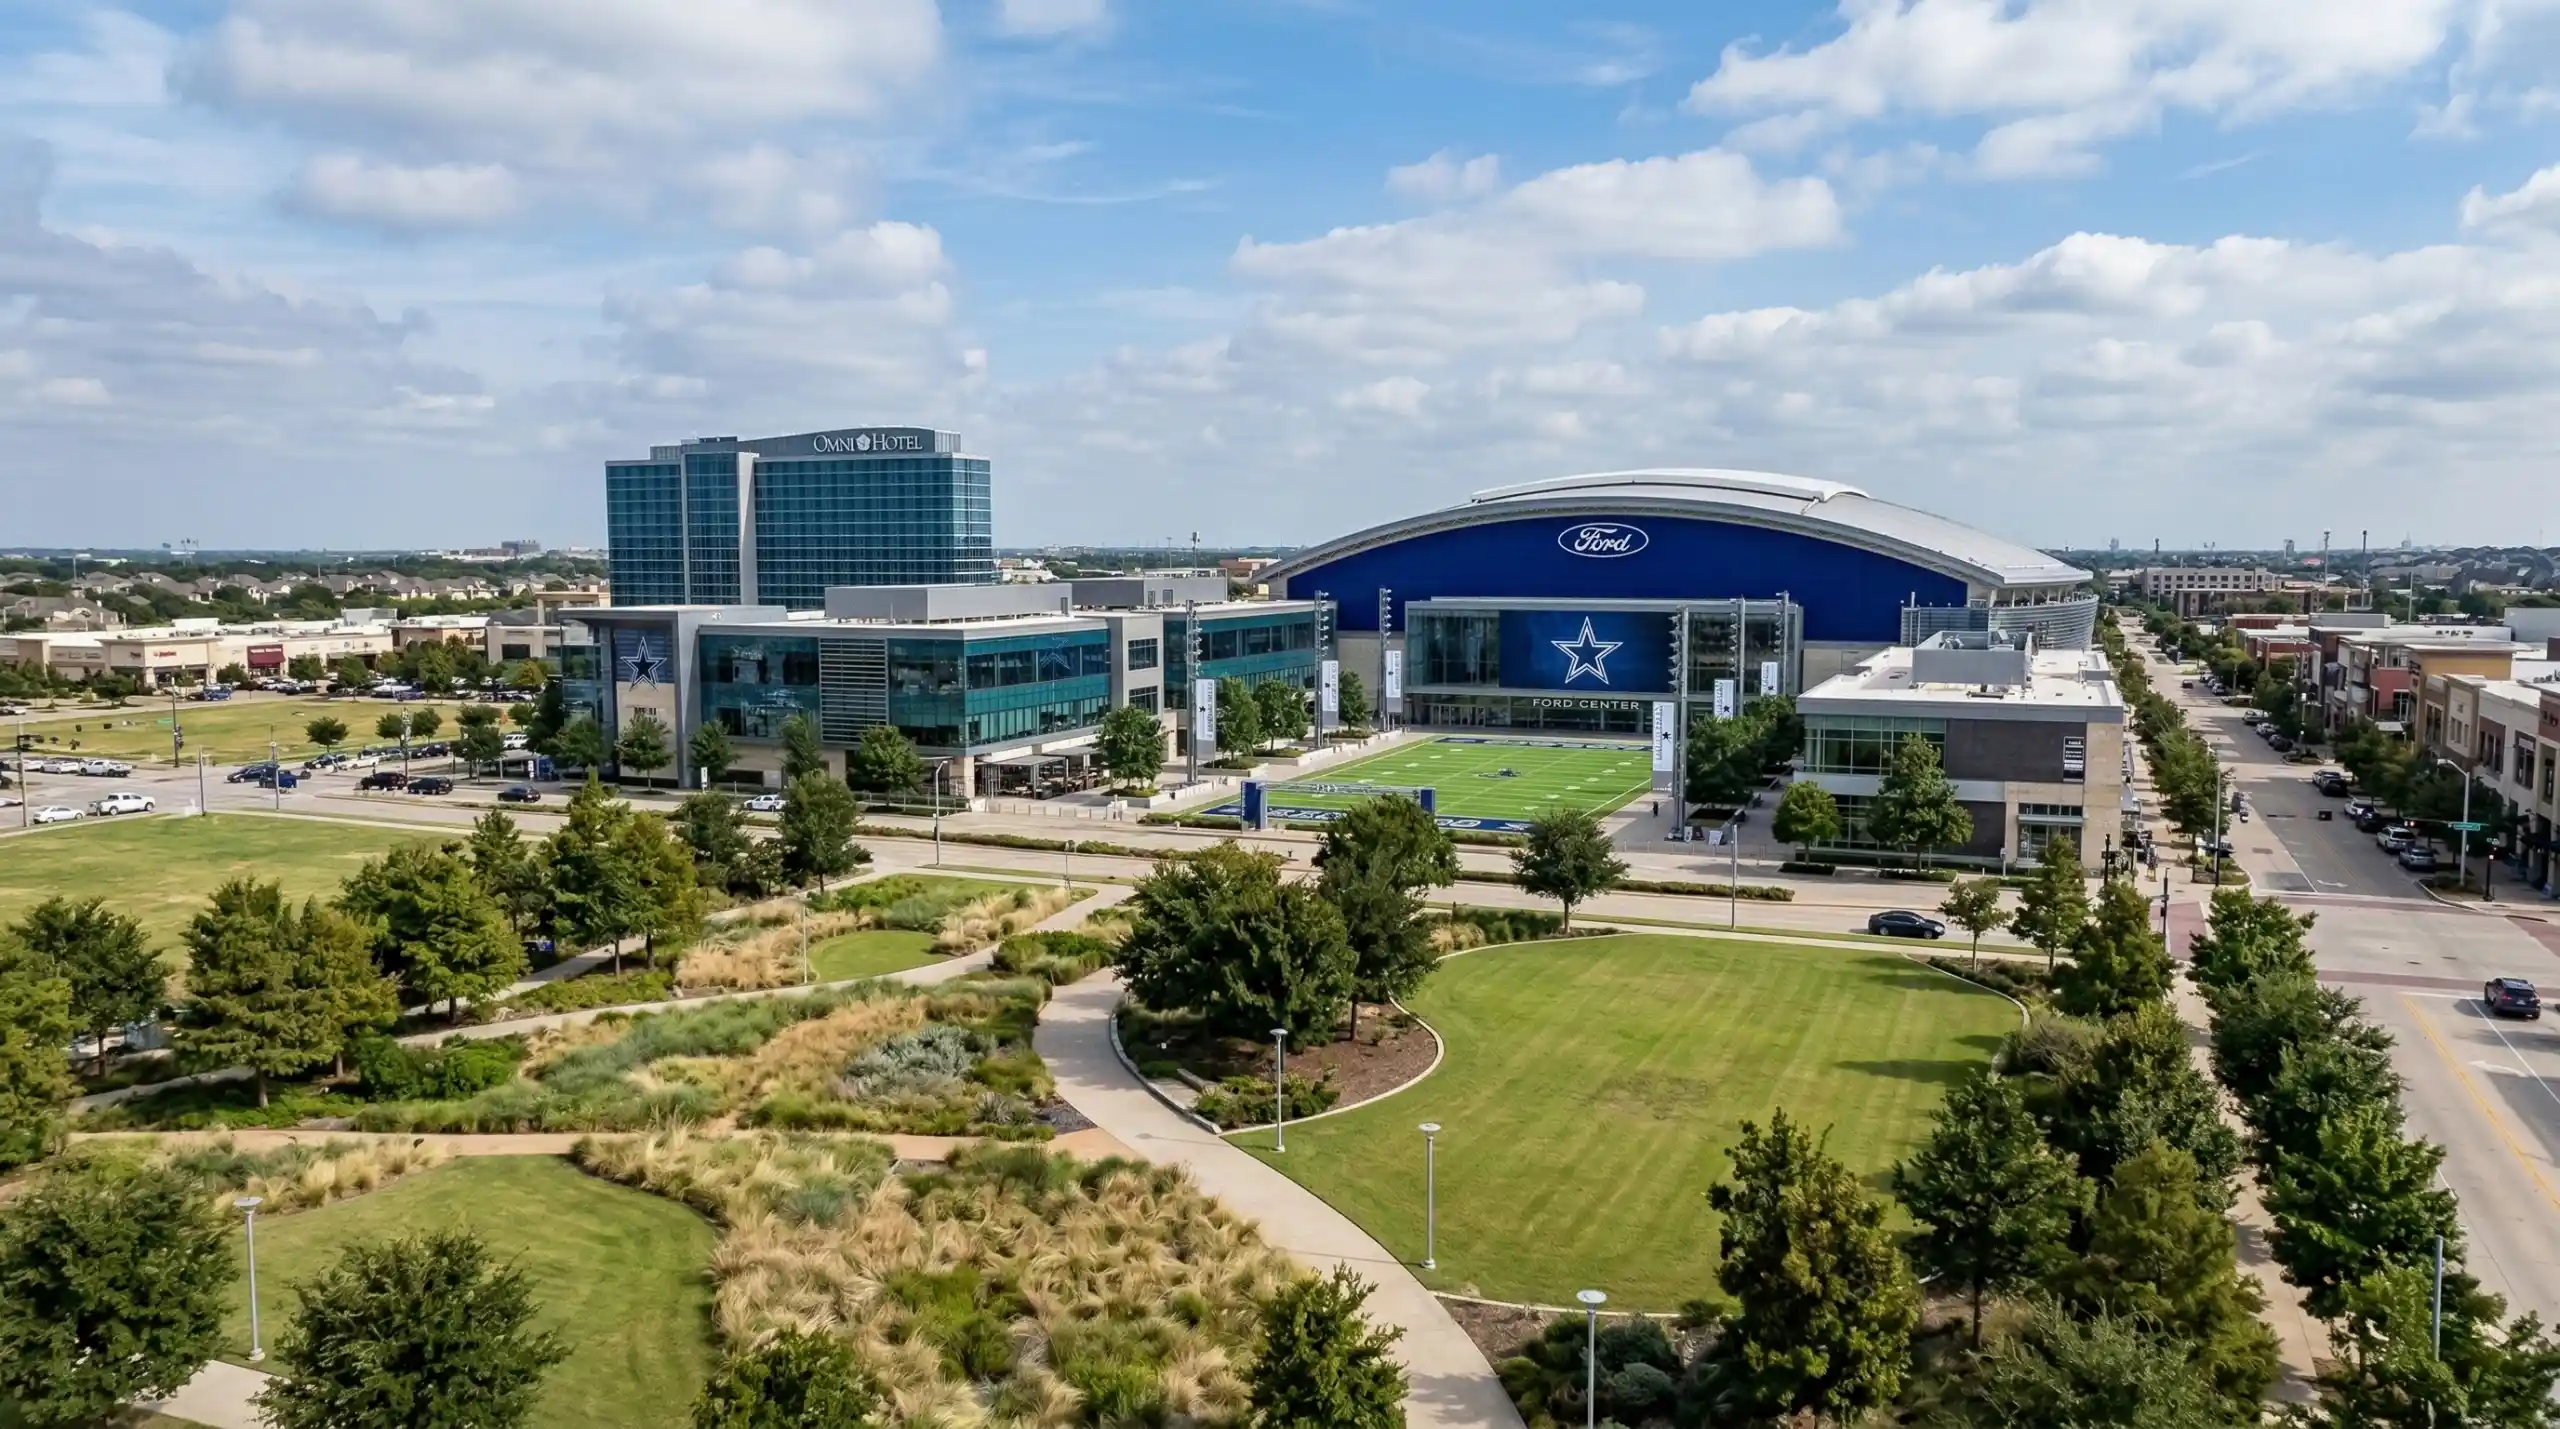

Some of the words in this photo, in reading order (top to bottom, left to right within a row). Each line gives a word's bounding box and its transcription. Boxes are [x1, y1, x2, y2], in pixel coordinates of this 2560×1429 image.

[1574, 527, 1632, 551] Ford
[1532, 698, 1573, 708] FORD
[1579, 699, 1640, 710] CENTER
